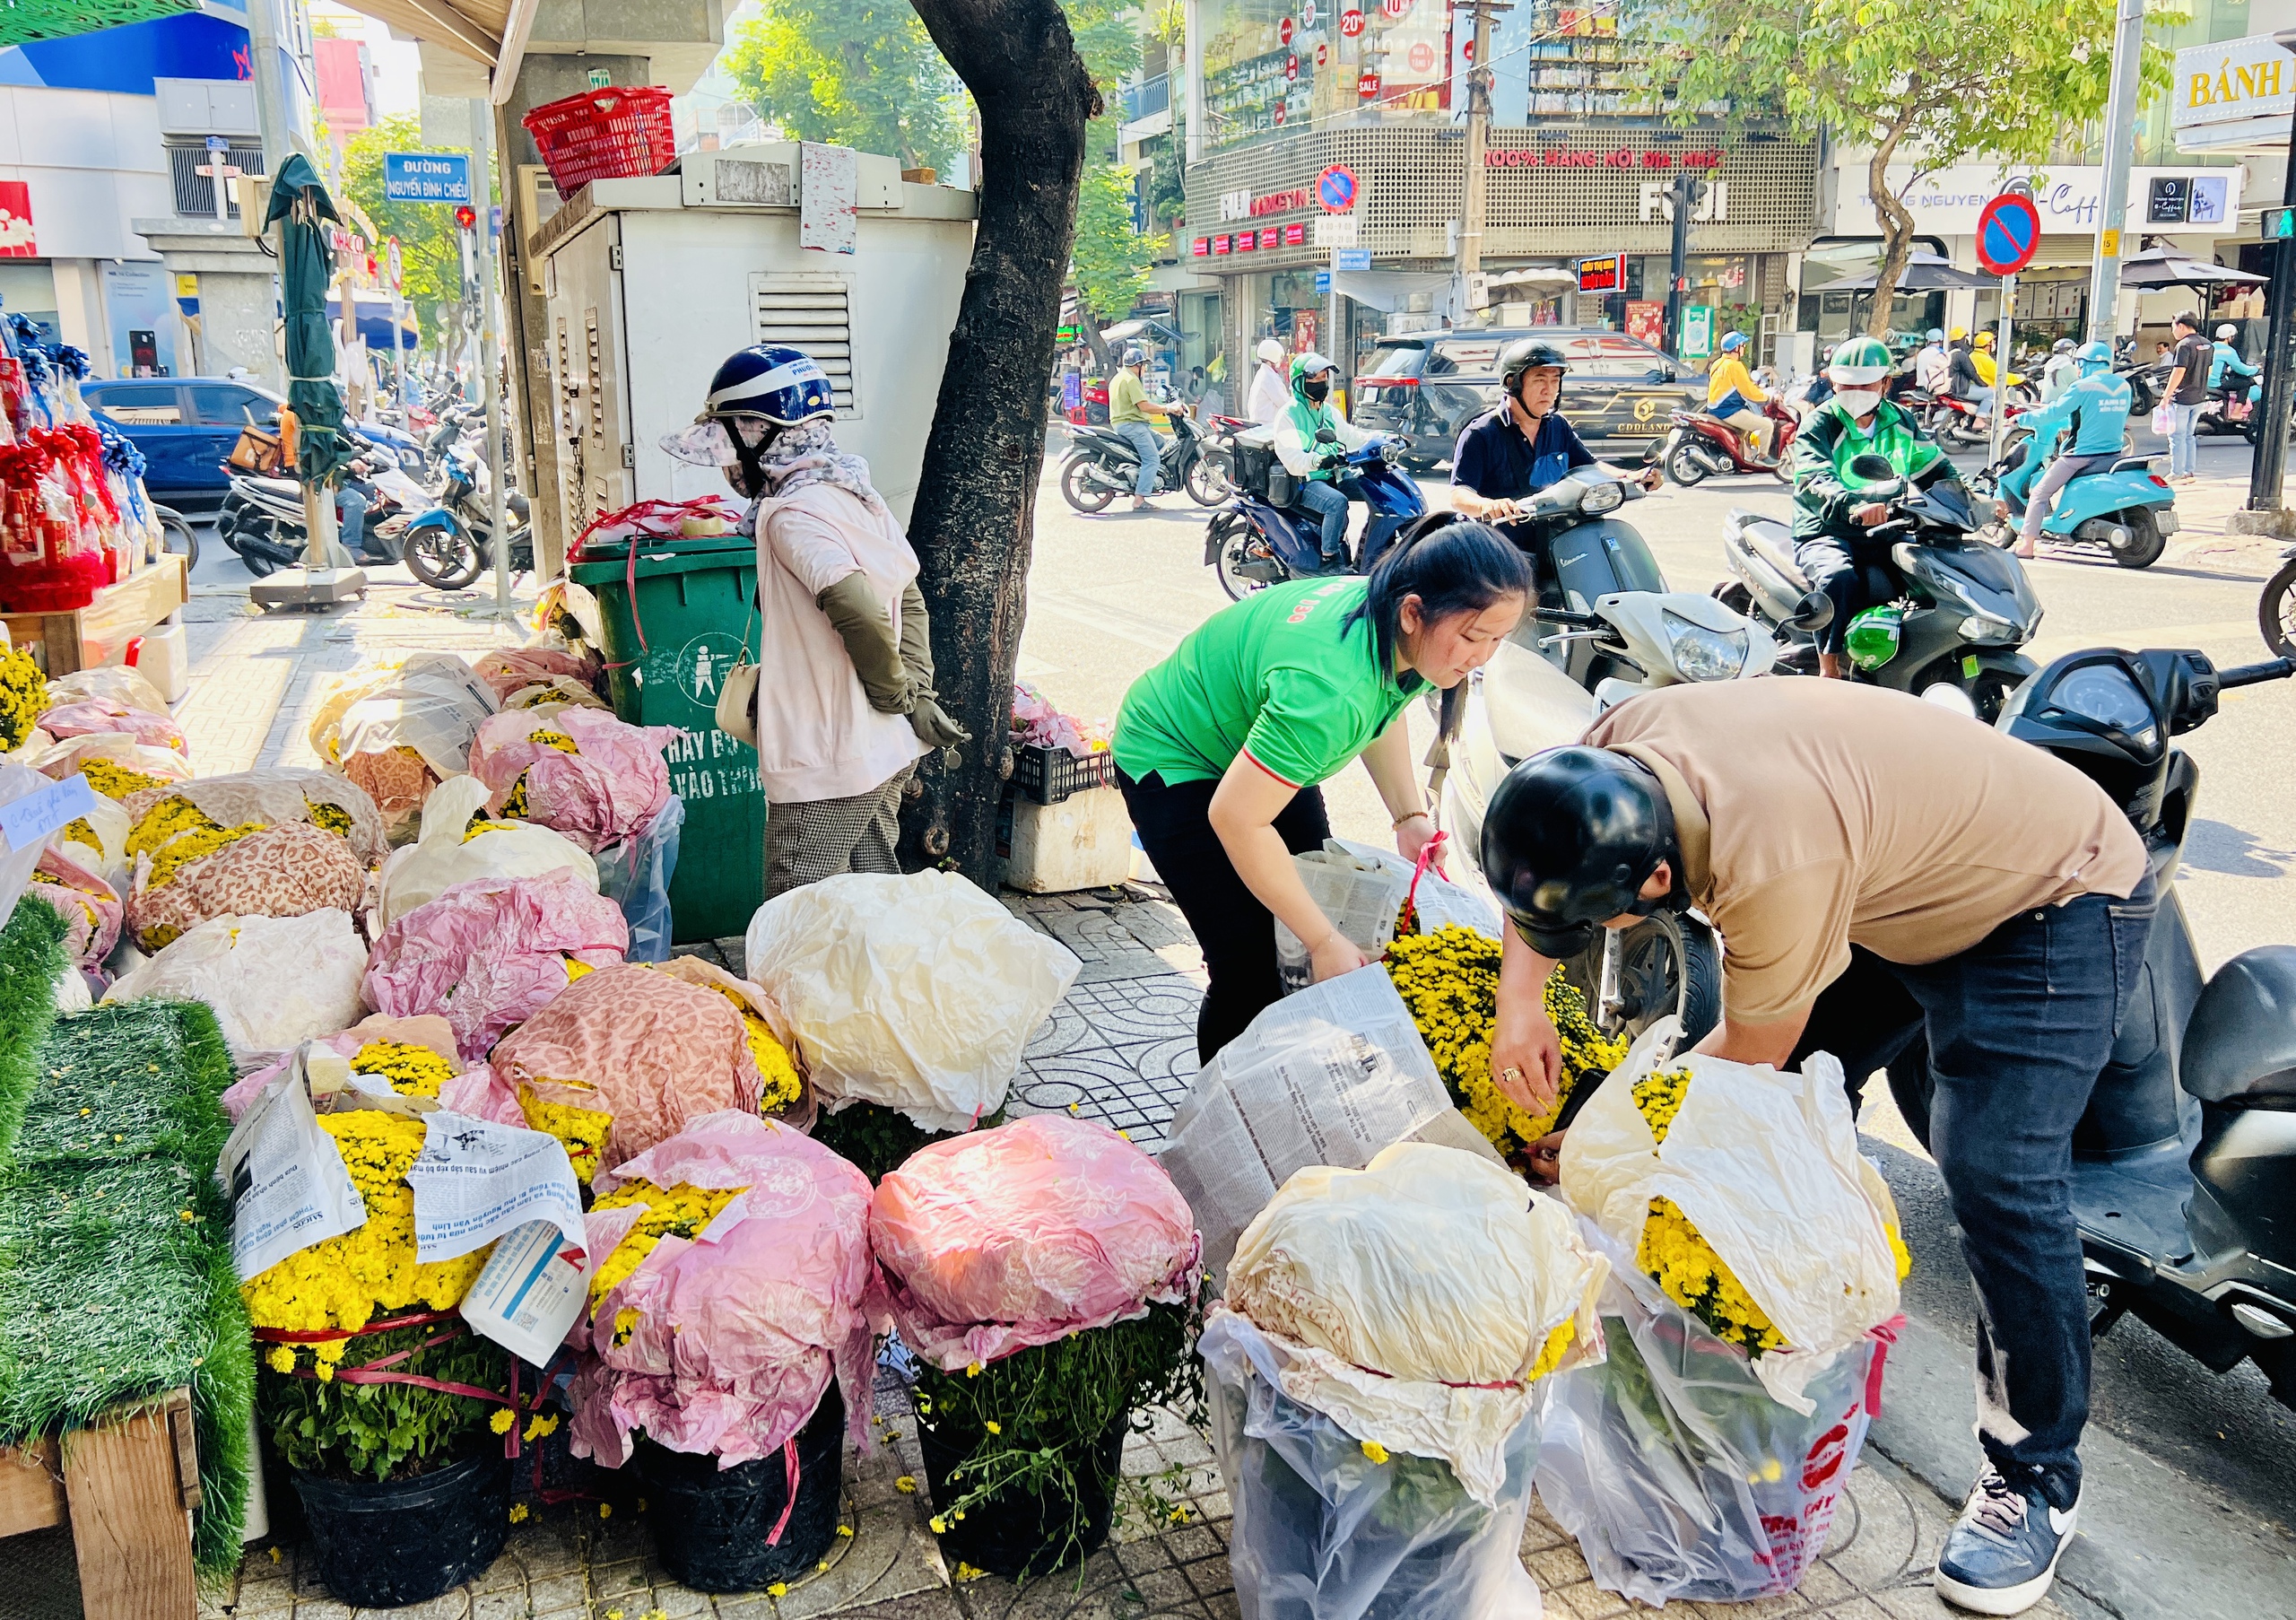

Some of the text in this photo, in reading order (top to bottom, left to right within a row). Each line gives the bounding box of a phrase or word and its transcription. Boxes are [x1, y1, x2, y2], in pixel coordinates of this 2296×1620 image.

[1342, 14, 1365, 32] 20%
[1359, 80, 1378, 92] SALE
[2187, 57, 2283, 108] BÁNH
[404, 159, 451, 174] ĐƯỜNG
[1544, 144, 1596, 168] HÀNG
[1604, 145, 1635, 172] NỘI
[388, 177, 466, 198] NGUYỄN ĐÌNH CHIỂU
[1921, 195, 1989, 206] NGUYEN
[674, 765, 714, 801] VÀO
[287, 1202, 314, 1223] TPHCM
[430, 1222, 450, 1230] Linh
